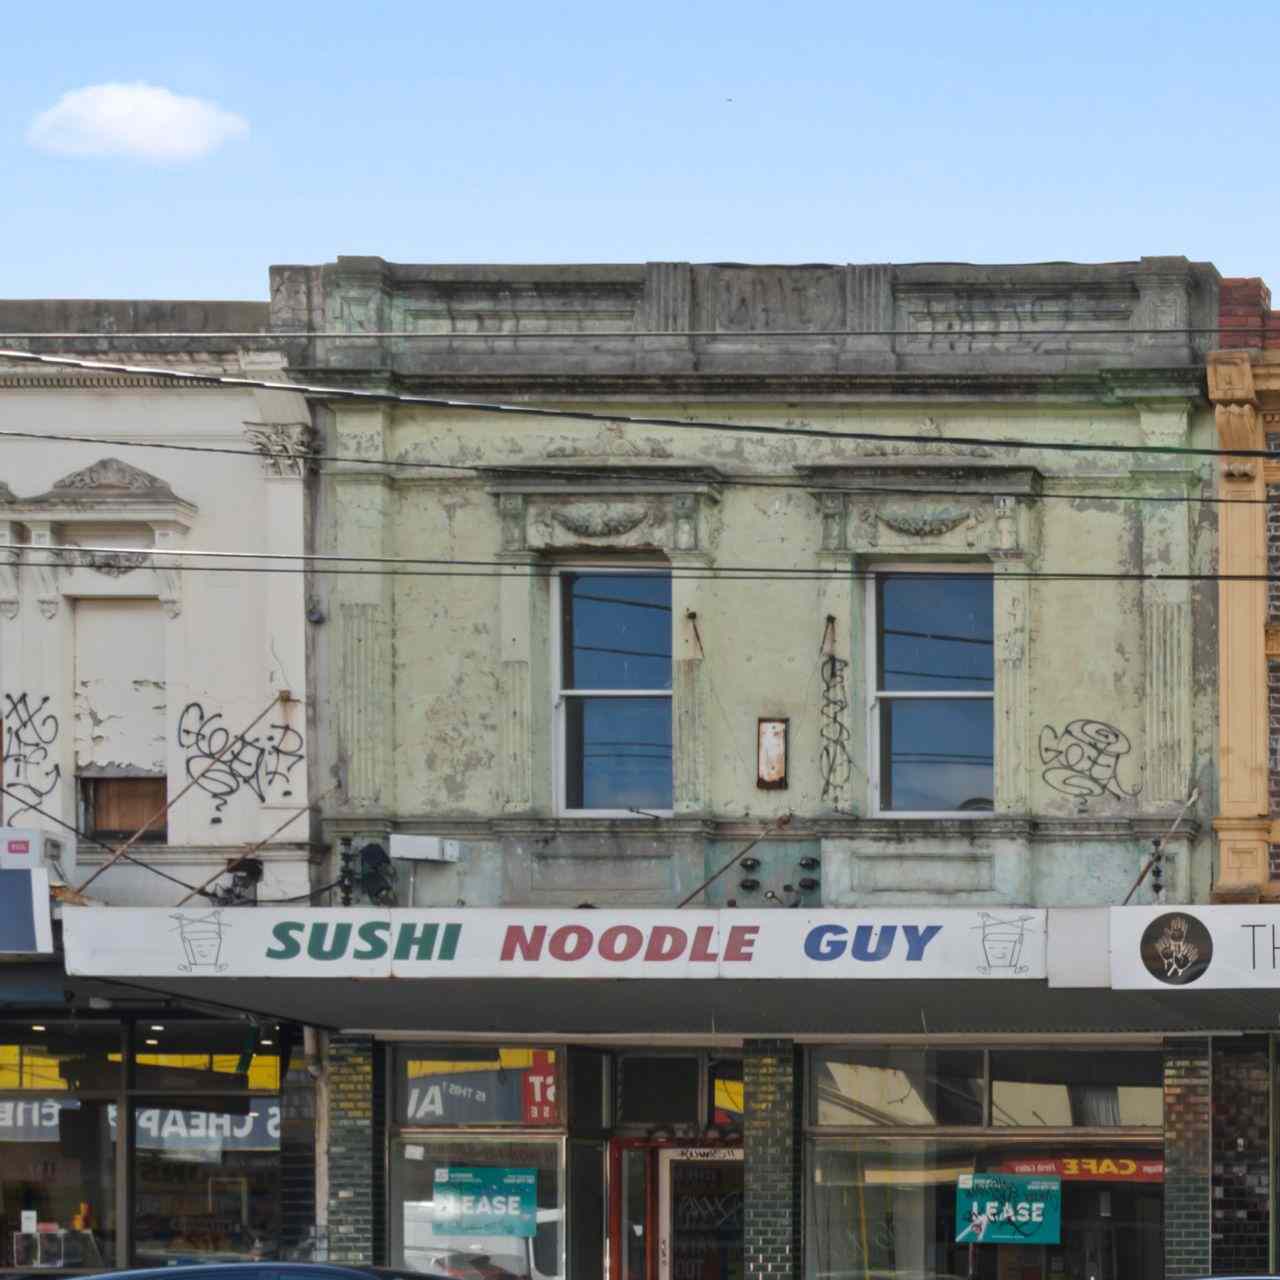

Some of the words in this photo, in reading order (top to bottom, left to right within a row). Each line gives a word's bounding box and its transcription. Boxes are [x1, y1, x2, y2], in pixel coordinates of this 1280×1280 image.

[265, 921, 462, 961] SUSHI
[500, 924, 760, 962] NOODLE
[803, 924, 943, 962] GUY
[971, 1201, 1045, 1223] LEASE
